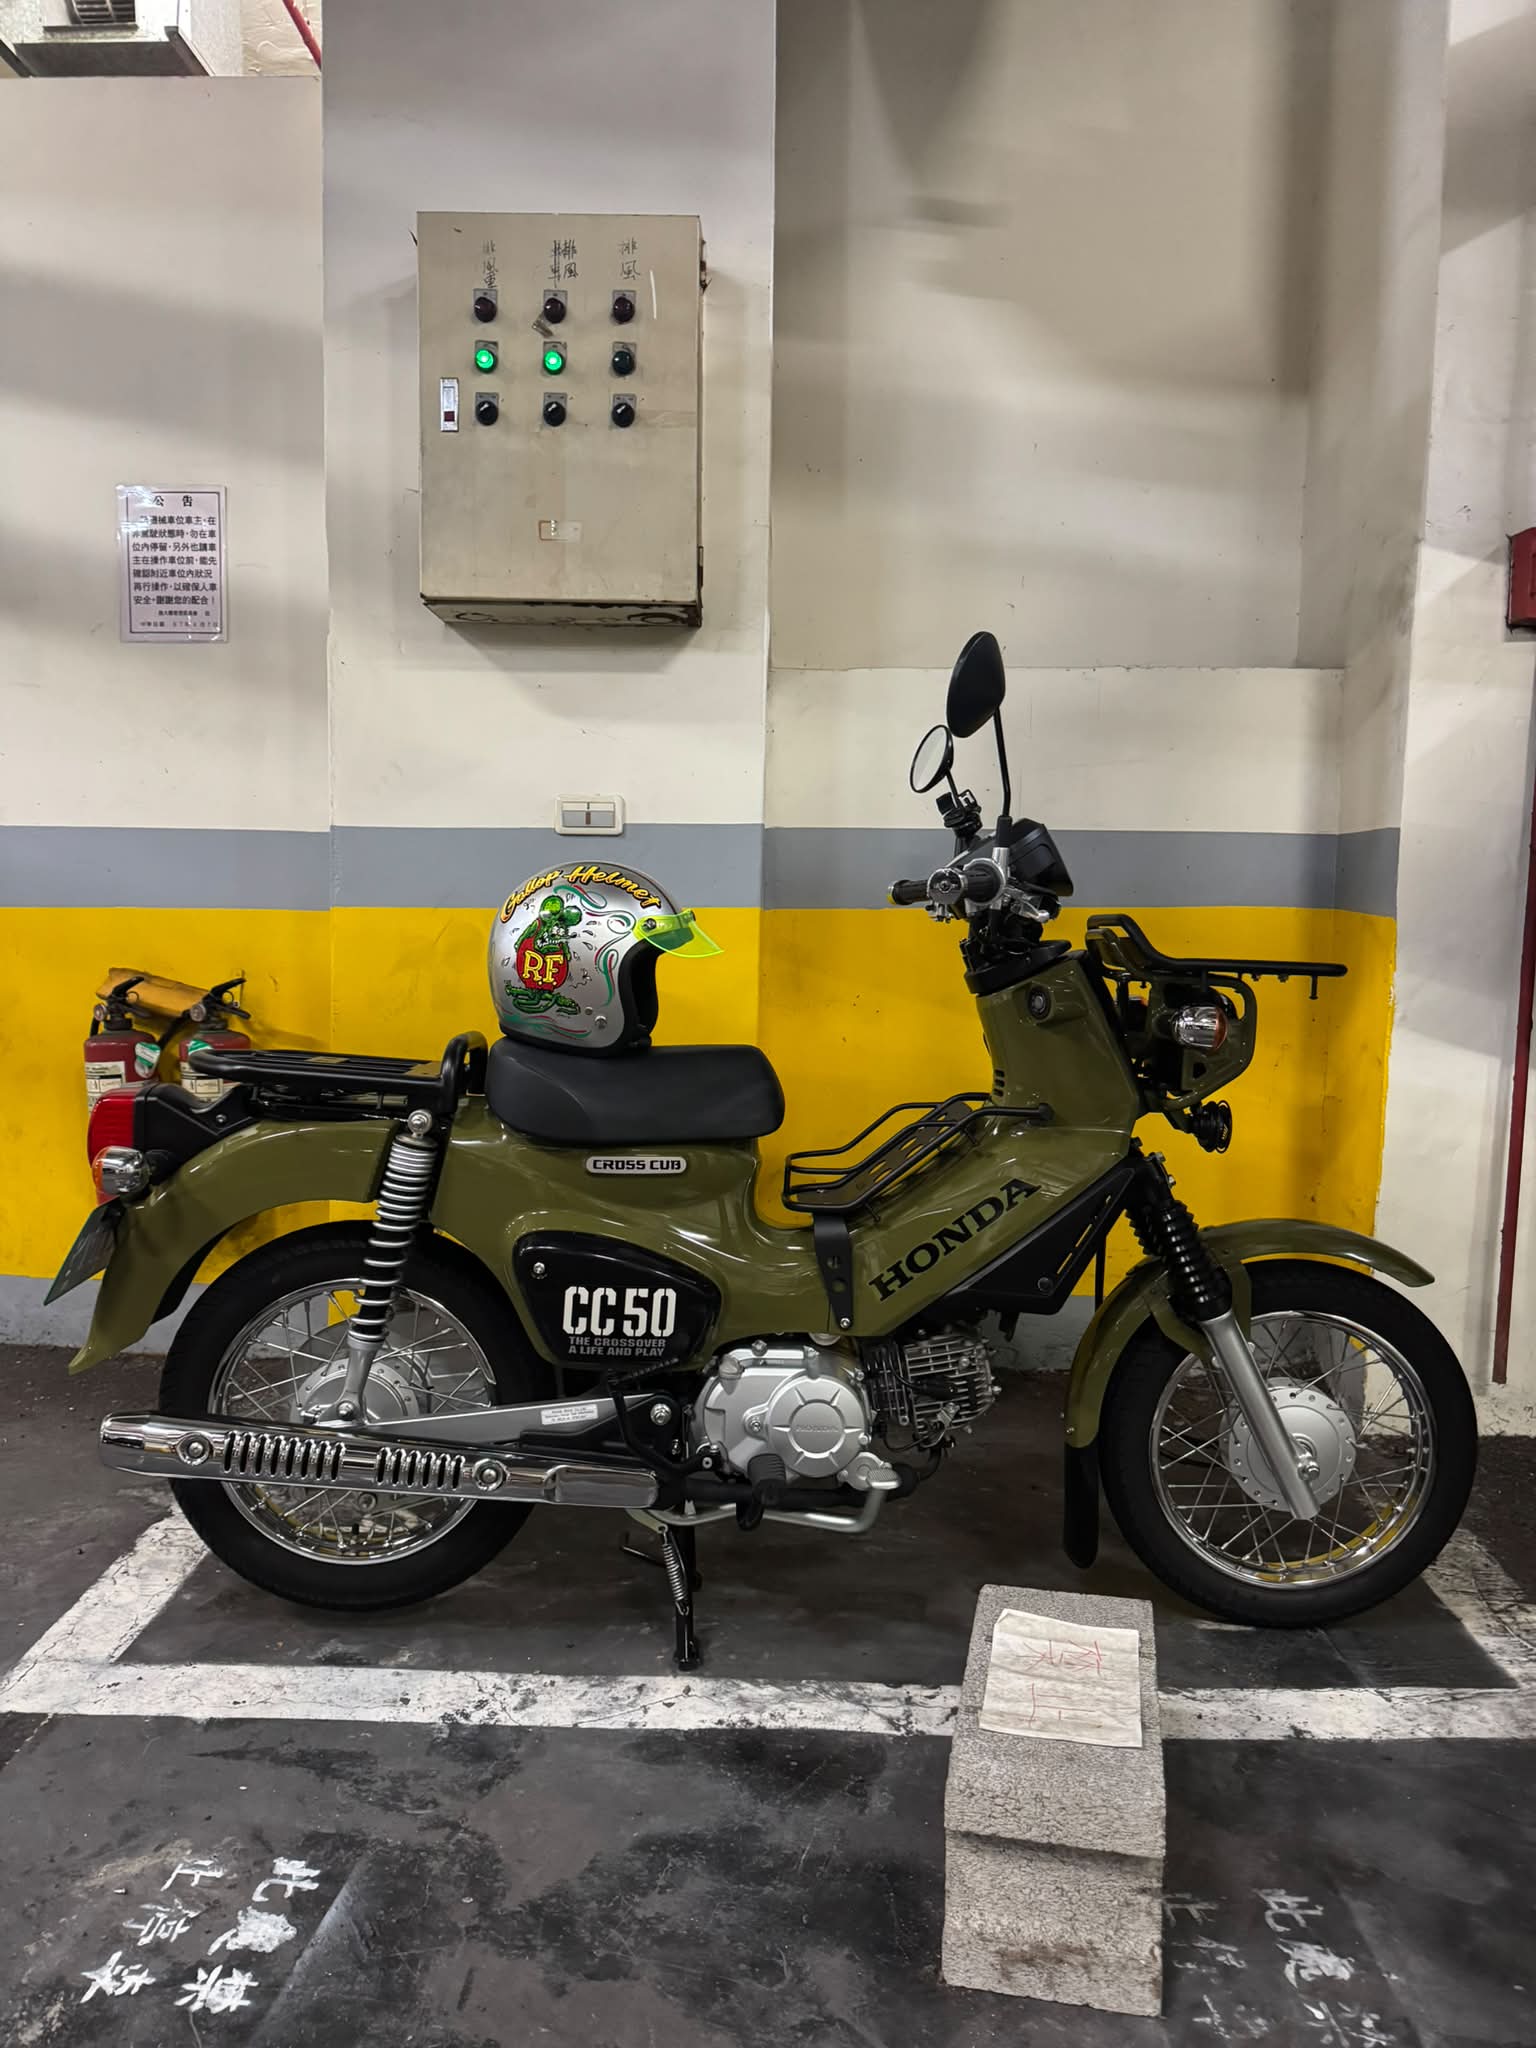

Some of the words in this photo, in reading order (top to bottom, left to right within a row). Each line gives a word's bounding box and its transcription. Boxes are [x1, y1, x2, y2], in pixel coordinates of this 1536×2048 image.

[618, 237, 640, 281] 排風
[563, 865, 661, 909] Helmet
[593, 1159, 645, 1170] CROSS
[650, 1159, 681, 1170] CUB
[868, 1178, 1042, 1301] HONDA
[568, 1336, 591, 1346] THE
[594, 1337, 666, 1348] CROSSOVER
[568, 1346, 577, 1354] A
[580, 1346, 604, 1355] LIFE
[606, 1347, 632, 1356] AND
[635, 1347, 665, 1357] PLAY
